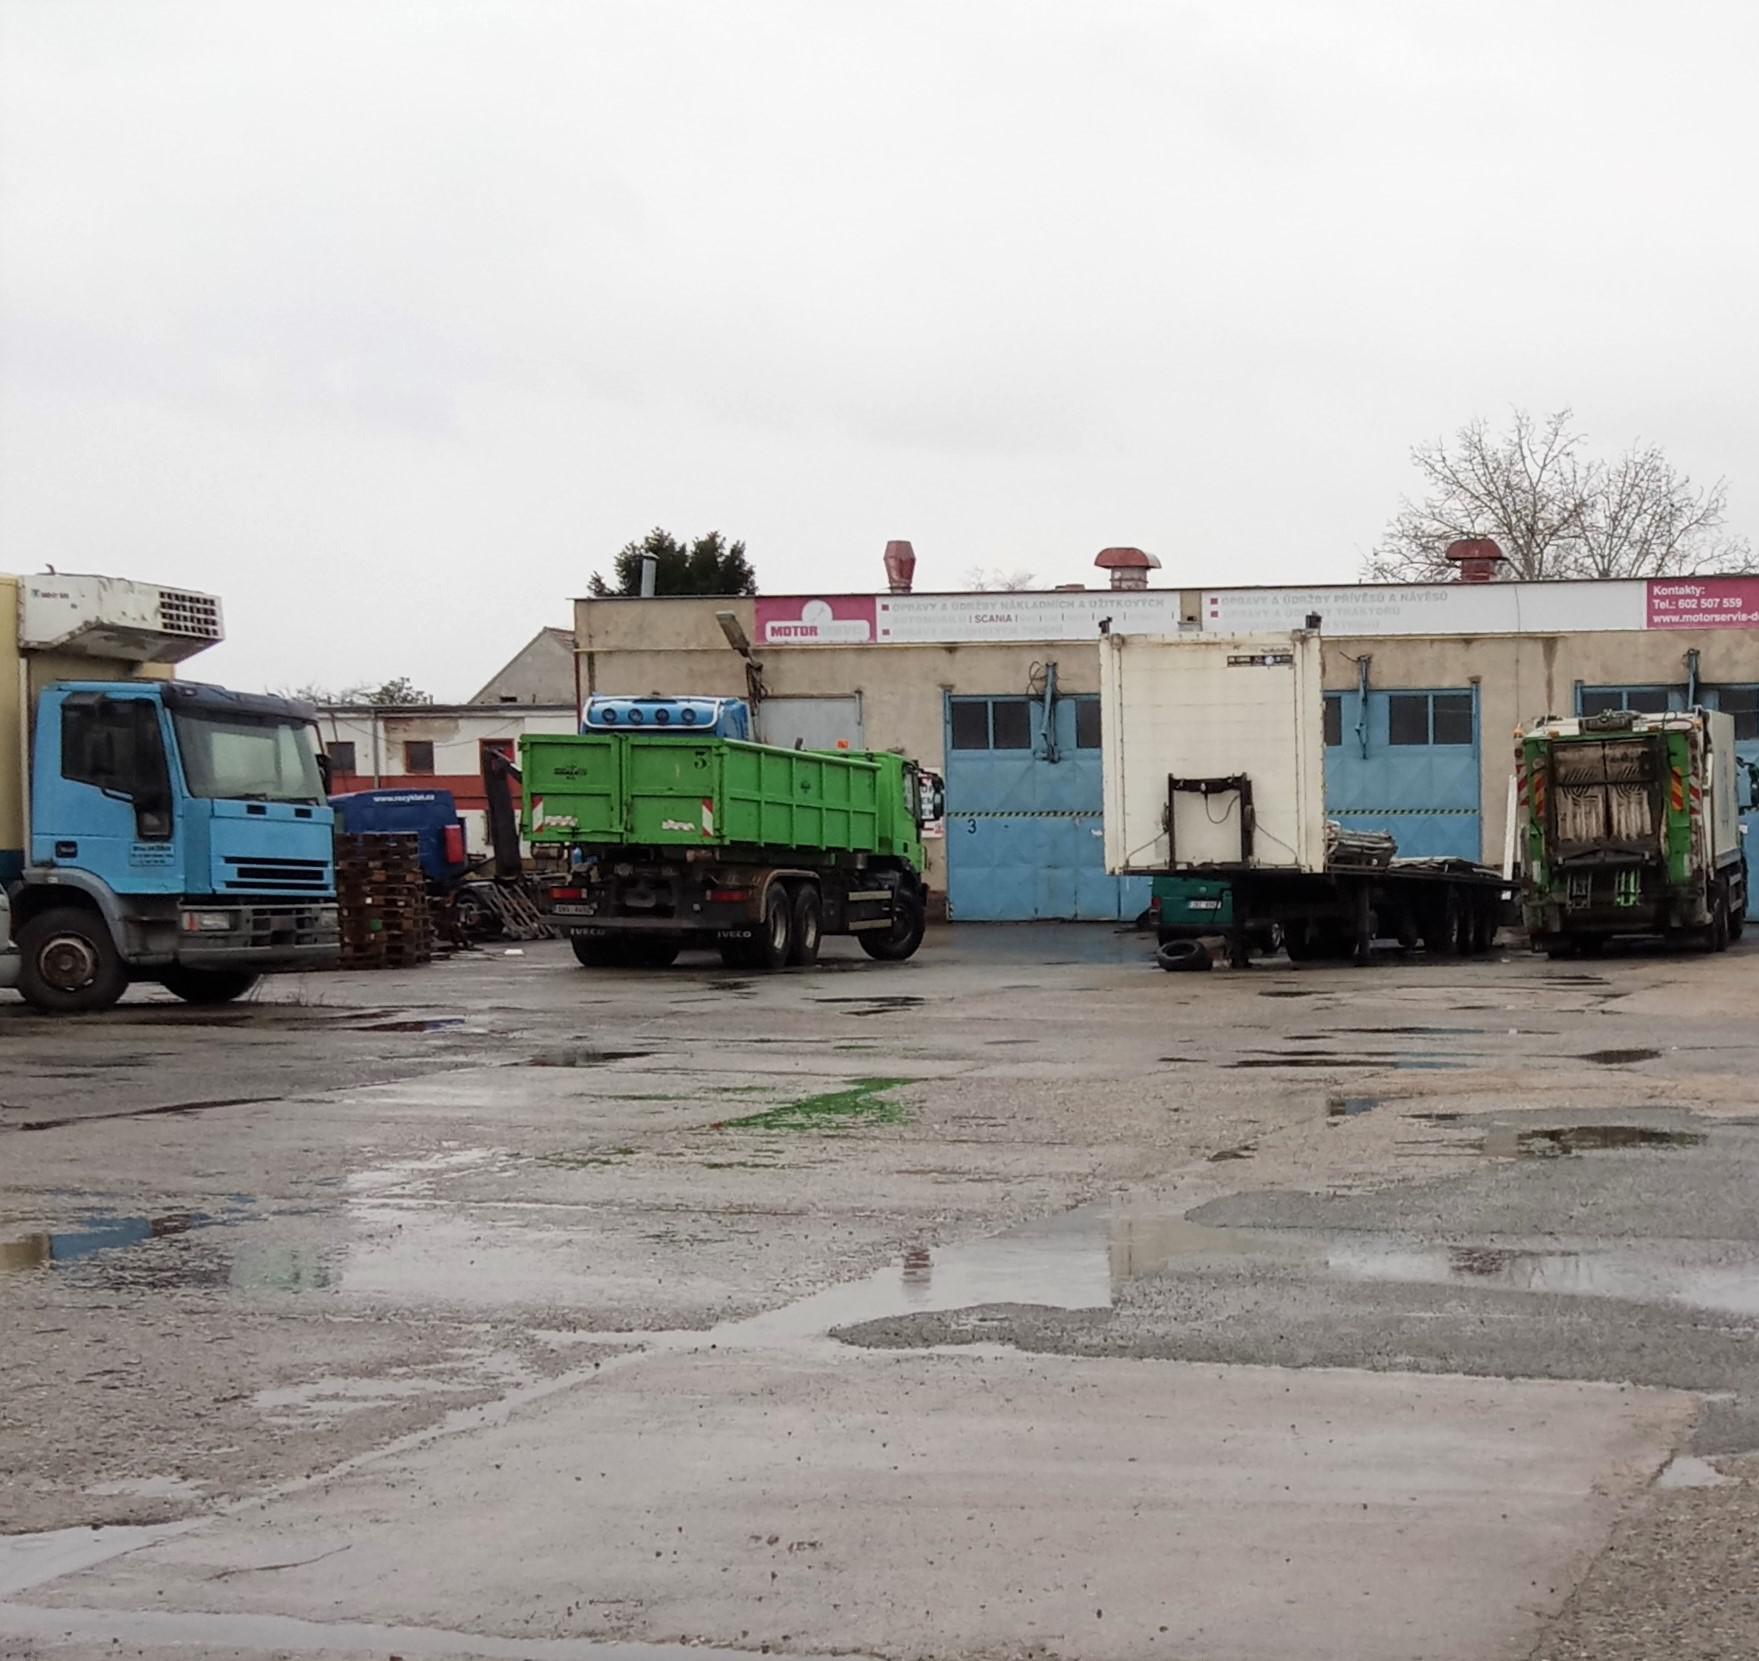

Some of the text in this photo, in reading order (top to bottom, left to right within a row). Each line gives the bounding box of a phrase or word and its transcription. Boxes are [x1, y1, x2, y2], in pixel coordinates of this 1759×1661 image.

[1653, 585, 1705, 597] Kontakty:
[1389, 593, 1396, 602] A
[1653, 598, 1742, 609] Tel.: 602 507 559
[974, 613, 1013, 623] SCANIA
[770, 625, 818, 637] MOTOR
[967, 818, 977, 834] 3
